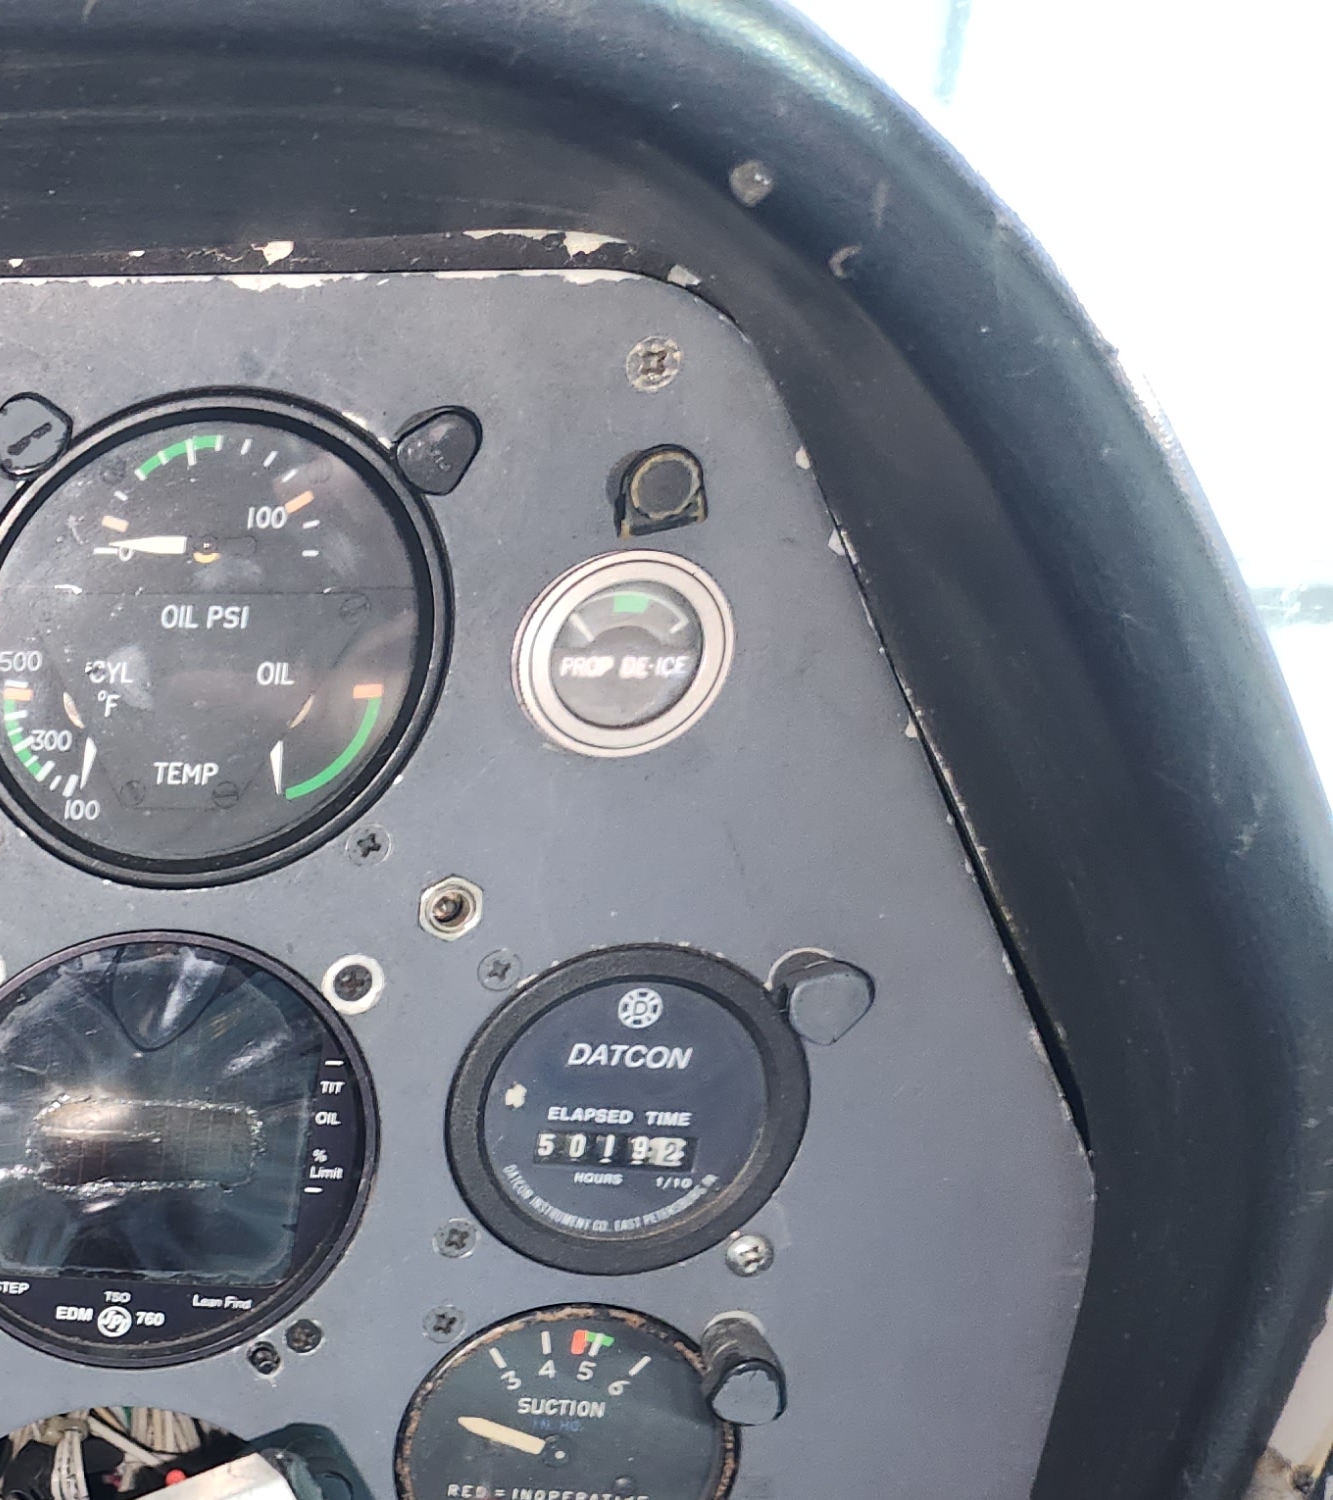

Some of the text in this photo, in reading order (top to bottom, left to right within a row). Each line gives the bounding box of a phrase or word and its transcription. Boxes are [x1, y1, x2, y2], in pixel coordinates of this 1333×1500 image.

[162, 606, 248, 629] OIL PSI
[257, 663, 294, 685] OIL
[560, 657, 613, 678] PROP
[154, 763, 218, 785] TEMP
[568, 1043, 693, 1069] DATCON
[315, 1112, 340, 1125] OIL
[548, 1107, 692, 1127] ELAPSED TIME
[574, 1172, 623, 1185] HOURS
[56, 1308, 92, 1321] EDM
[135, 1312, 165, 1326] 760
[518, 1398, 606, 1418] SUCTION
[447, 1484, 486, 1499] RED
